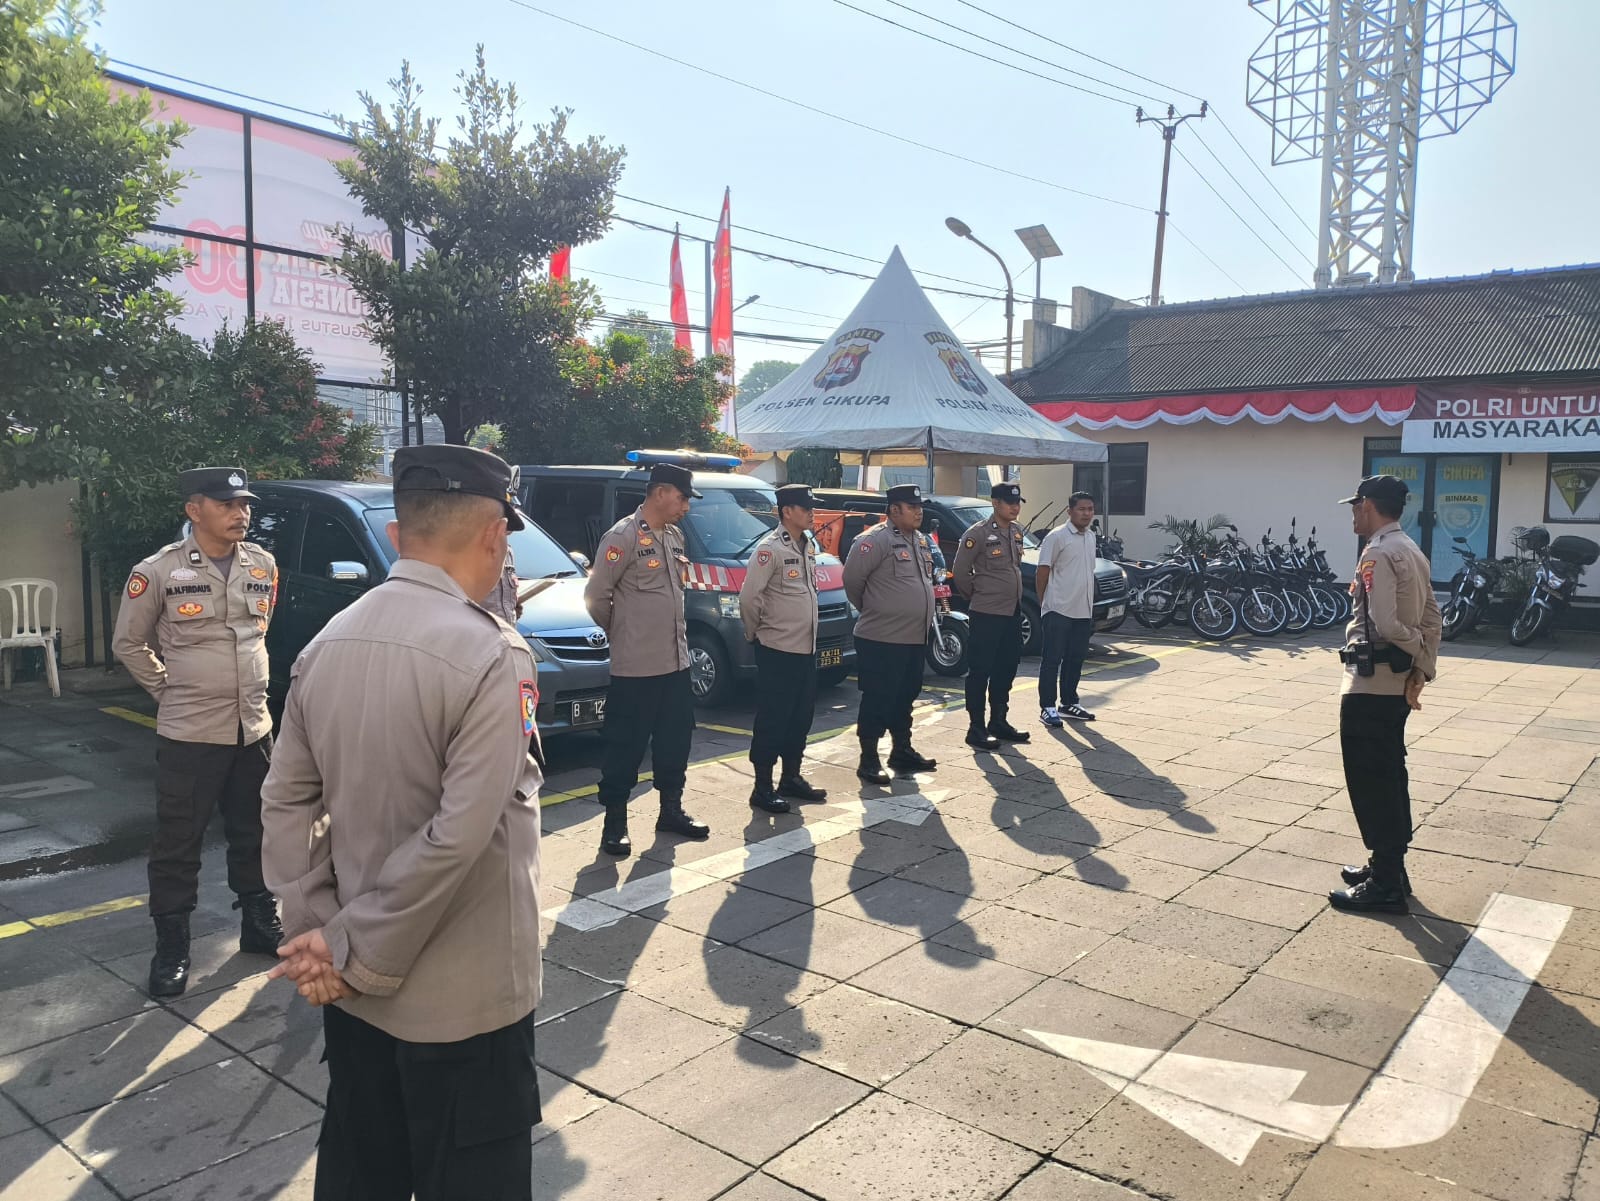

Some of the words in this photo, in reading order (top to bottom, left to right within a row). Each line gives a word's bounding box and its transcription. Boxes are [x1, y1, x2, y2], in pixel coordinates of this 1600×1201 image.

[754, 397, 816, 412] POLSEK
[822, 396, 890, 406] CIKUPA
[936, 398, 988, 411] POLSEK
[1436, 399, 1512, 417] POLRI
[1521, 396, 1600, 415] UNTU
[1433, 418, 1600, 438] MASYARAKA
[1443, 465, 1486, 480] CIKUPA
[574, 703, 580, 717] B
